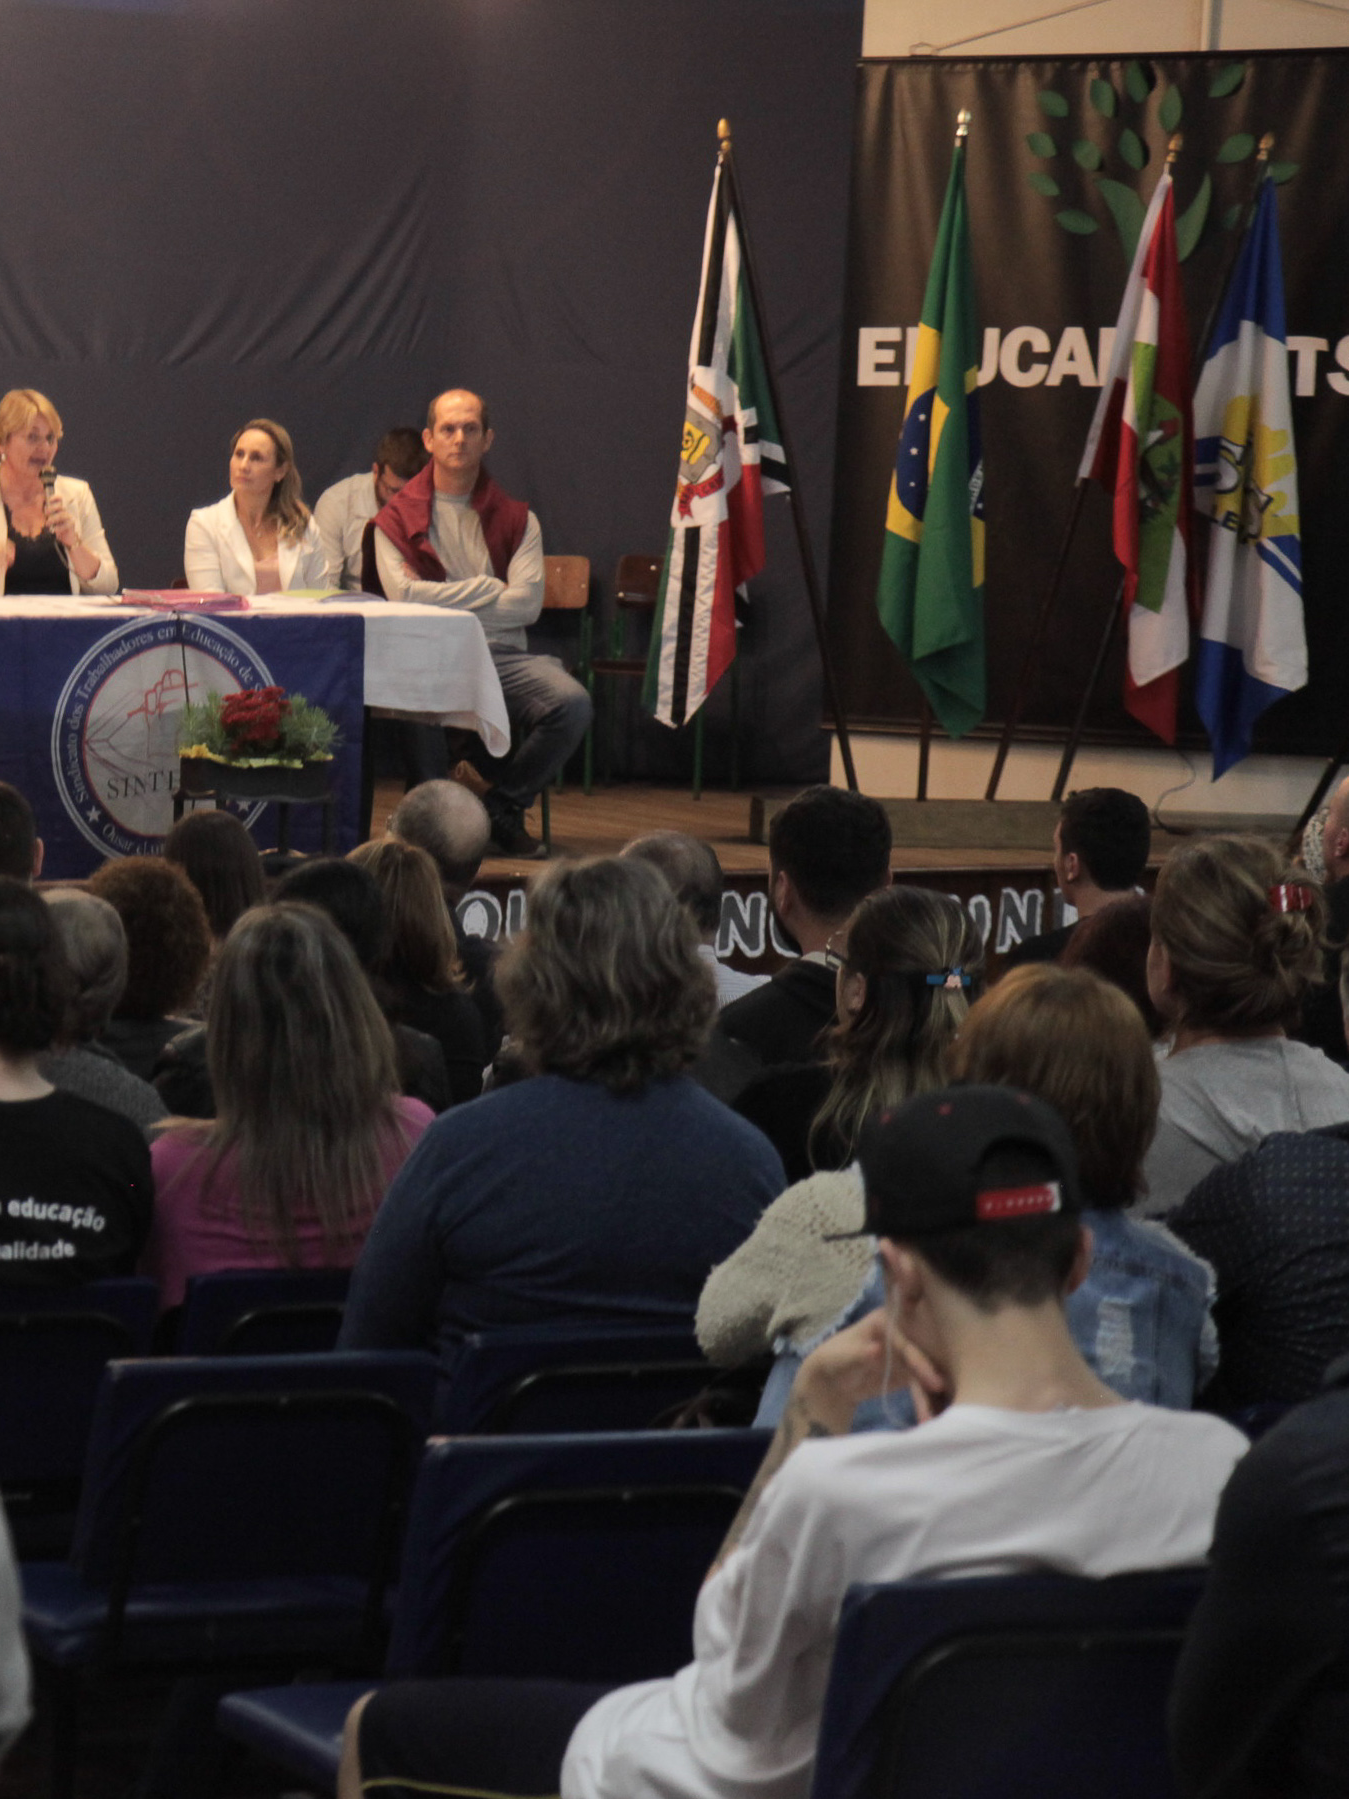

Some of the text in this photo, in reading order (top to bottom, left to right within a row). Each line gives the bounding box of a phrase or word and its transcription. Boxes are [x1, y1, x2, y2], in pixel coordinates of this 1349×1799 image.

[75, 631, 154, 700] Trabalhadores
[182, 623, 240, 668] Educação
[238, 666, 253, 683] de
[67, 703, 84, 730] dos
[67, 733, 89, 803] Sindicato
[7, 1196, 106, 1233] educação
